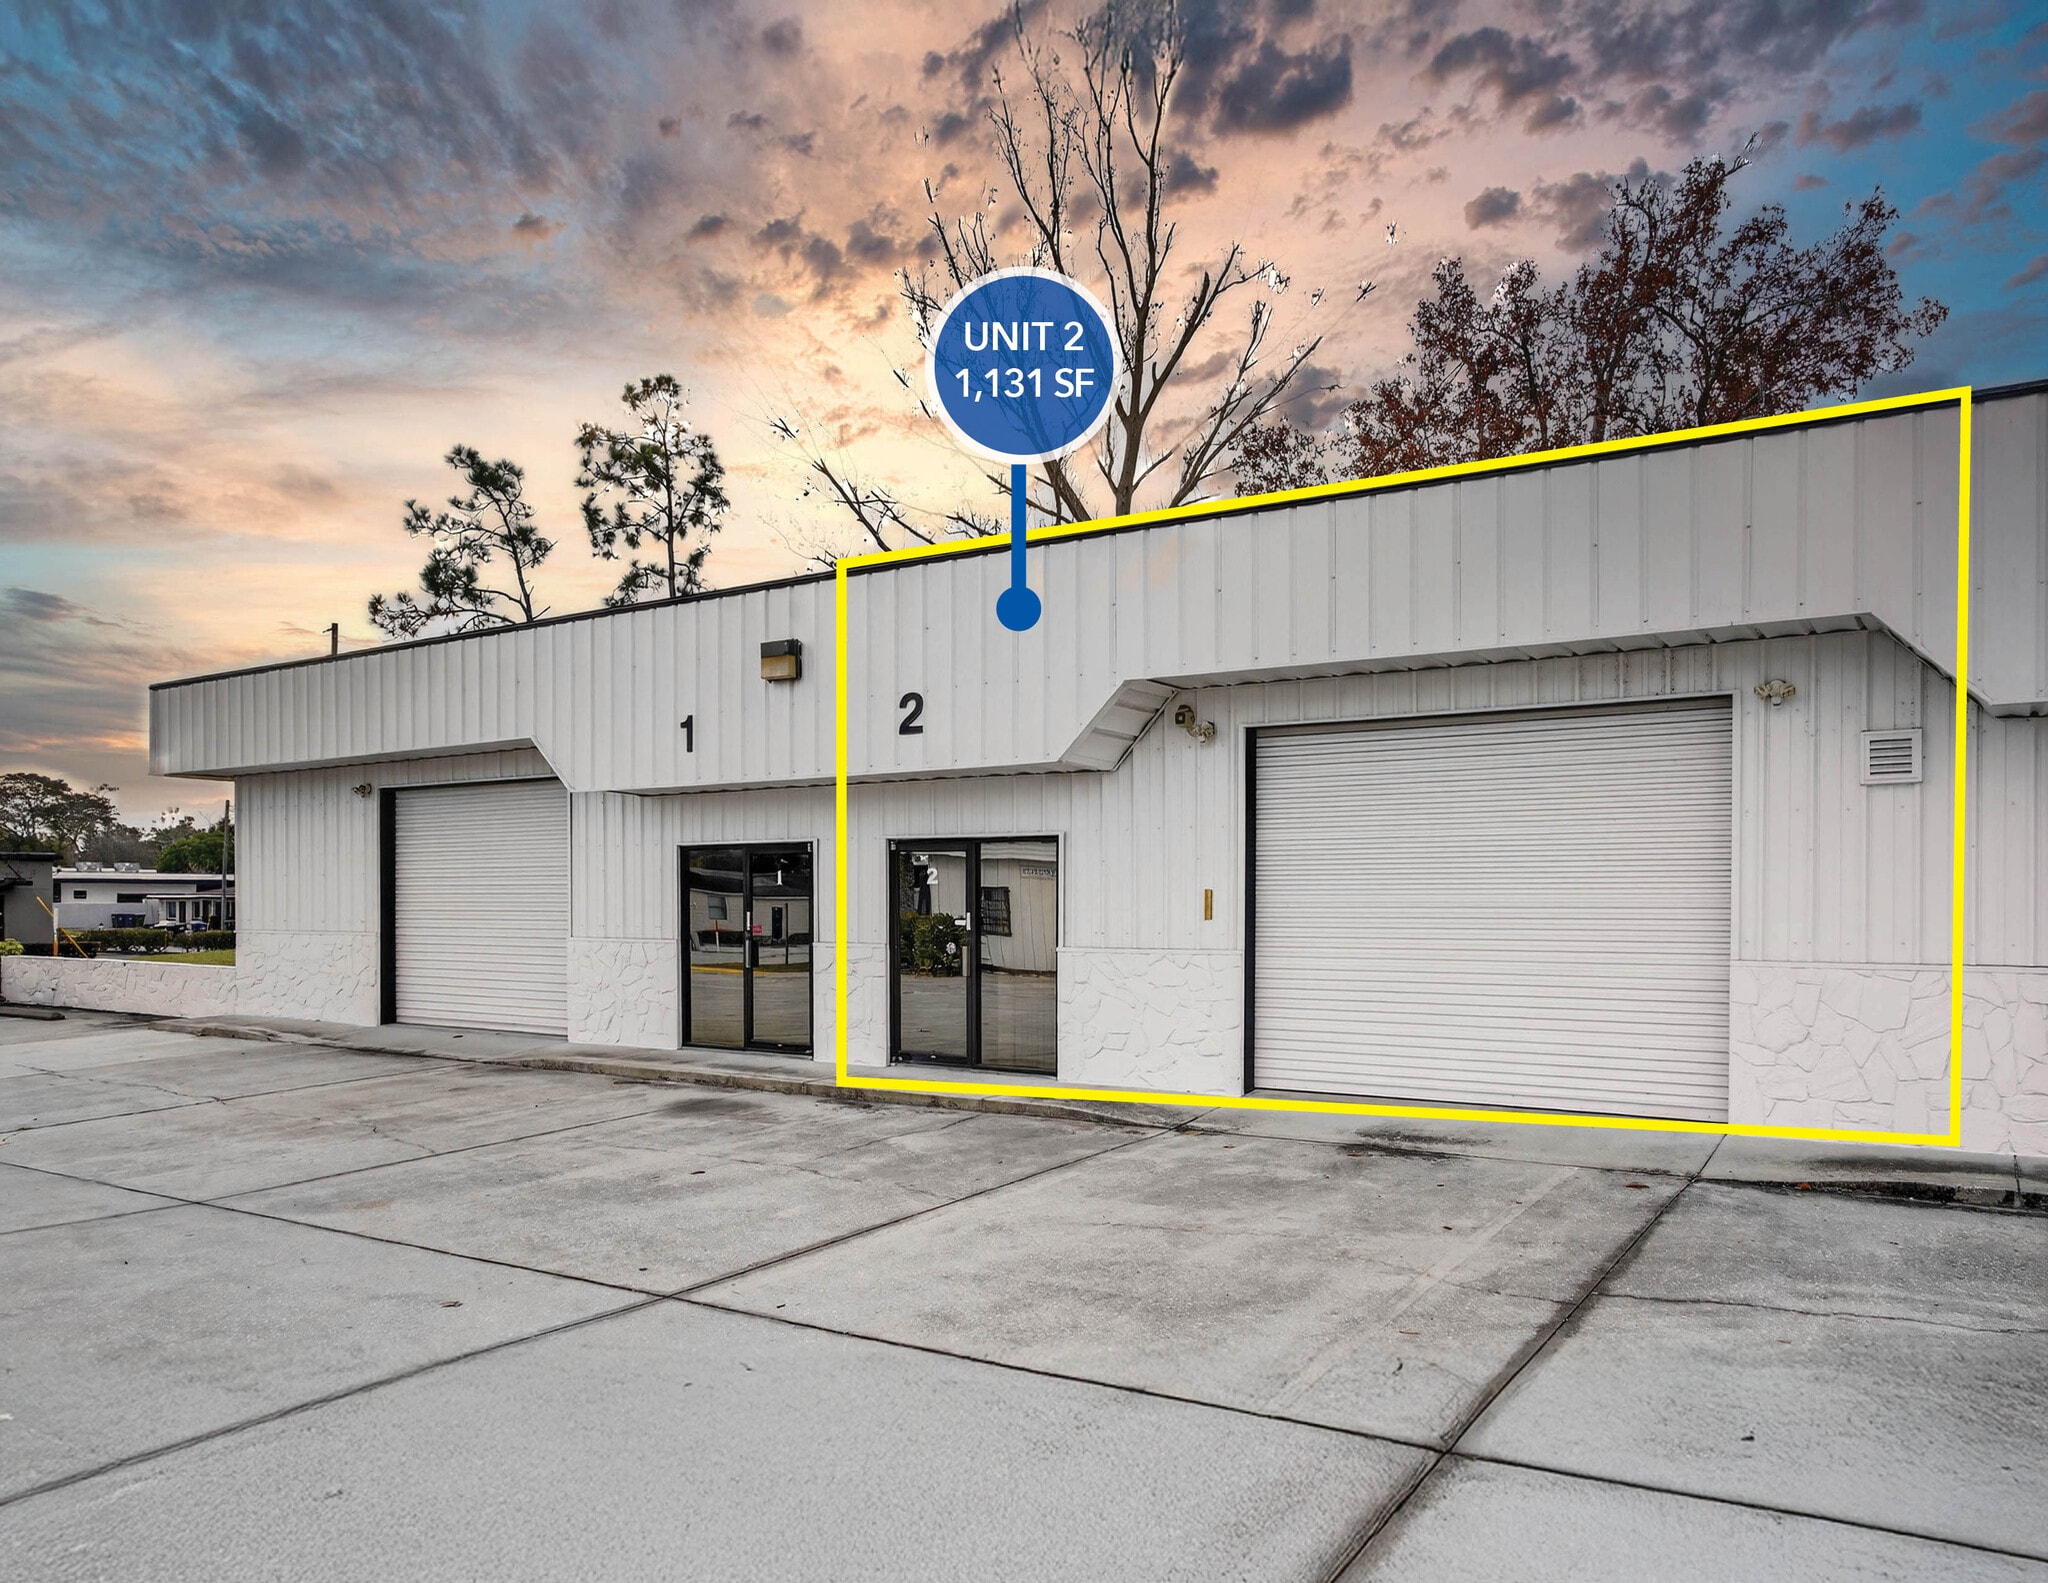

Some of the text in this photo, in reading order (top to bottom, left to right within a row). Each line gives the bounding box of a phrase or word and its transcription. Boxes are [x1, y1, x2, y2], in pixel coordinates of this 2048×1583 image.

[899, 692, 924, 735] 2
[680, 714, 694, 753] 1
[926, 867, 939, 885] 2
